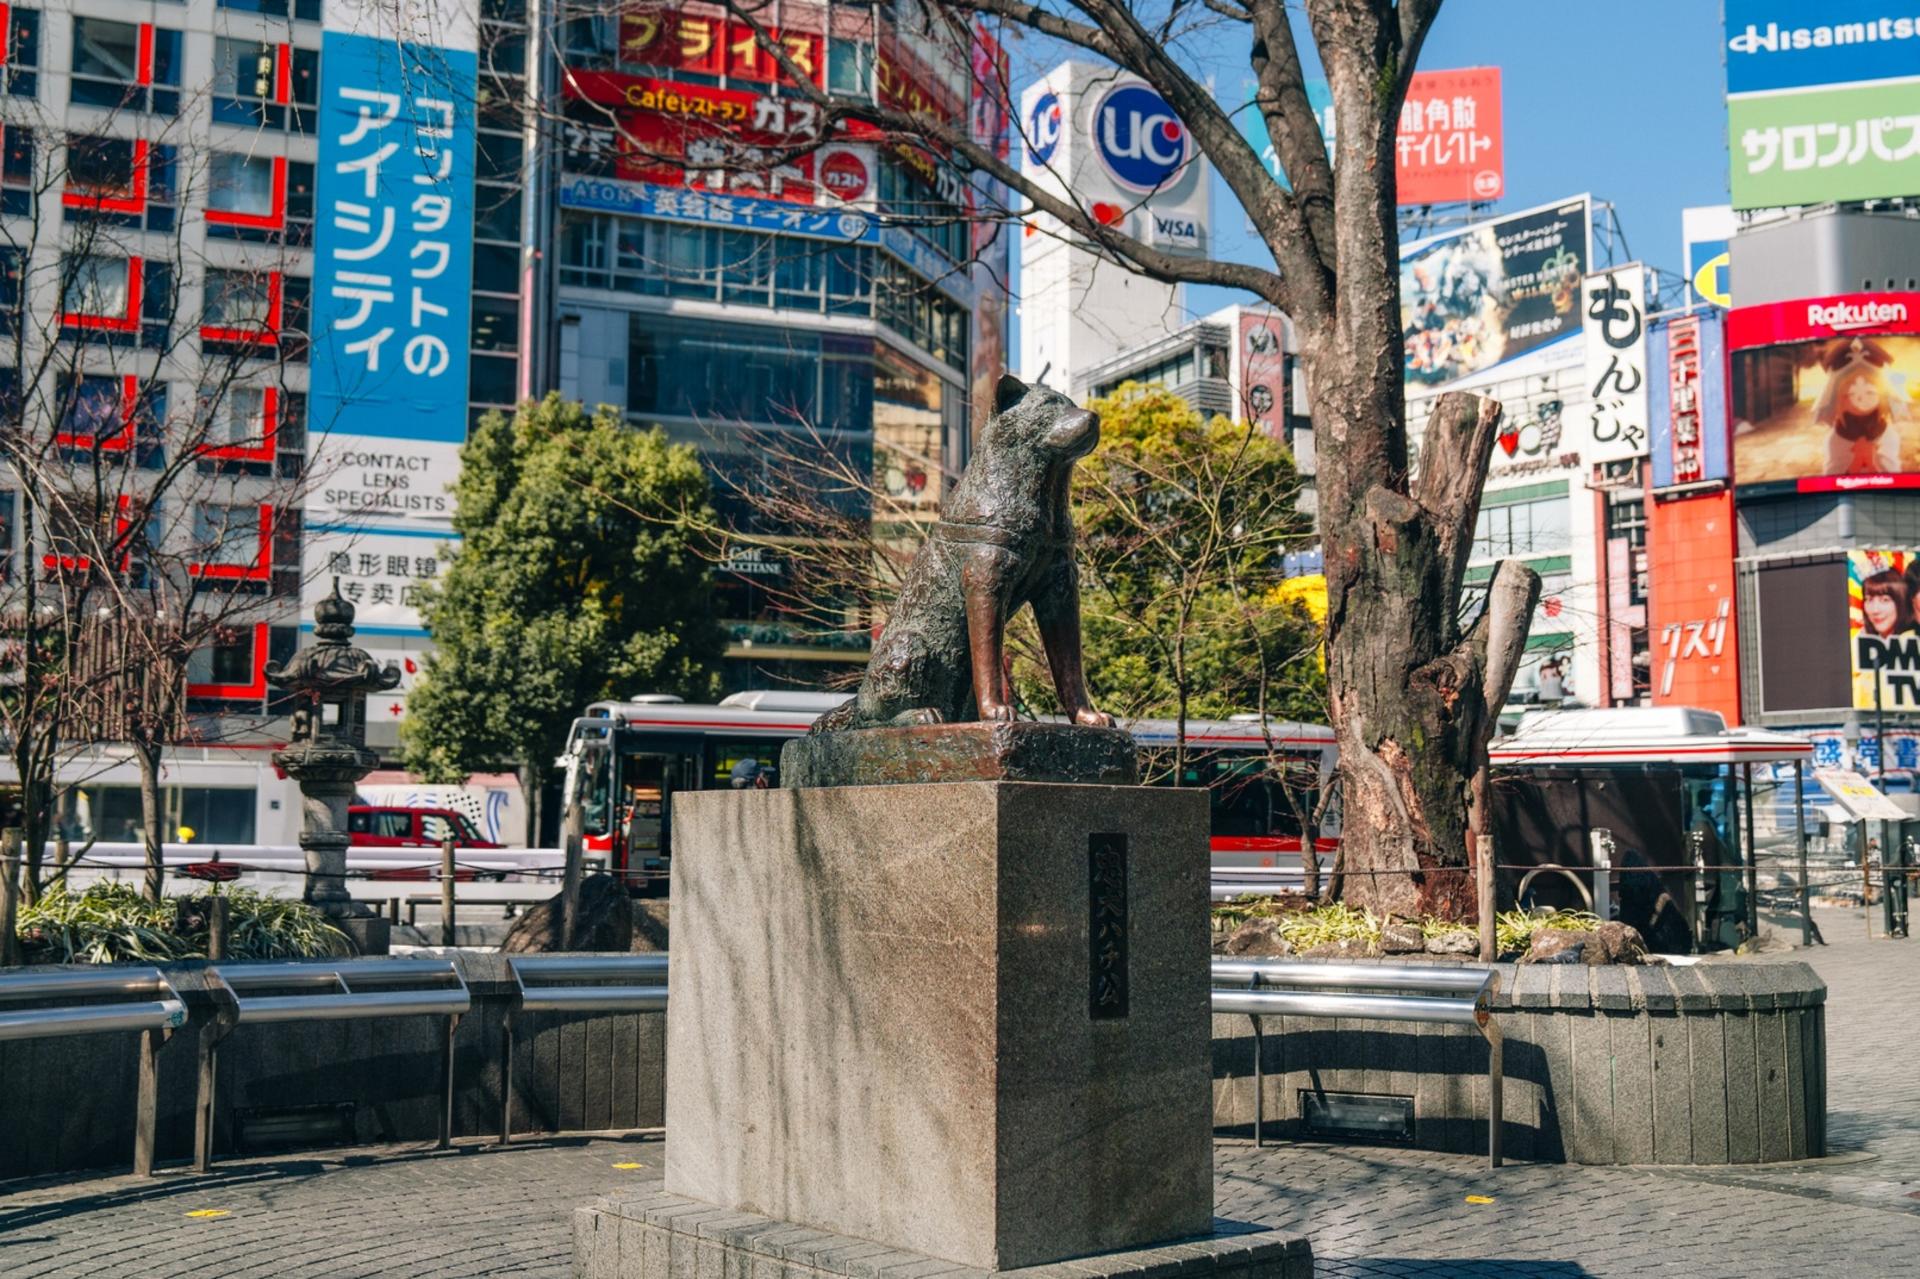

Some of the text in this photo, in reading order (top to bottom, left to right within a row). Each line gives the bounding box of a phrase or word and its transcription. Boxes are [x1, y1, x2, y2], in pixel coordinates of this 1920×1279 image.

[1103, 105, 1180, 166] UC
[1742, 115, 1920, 174] サロンパス
[827, 171, 865, 188] ガスト
[332, 87, 399, 373] アイシティ
[403, 97, 455, 377] コンタクトの
[1158, 219, 1196, 238] VISA
[1808, 301, 1907, 327] Rakuten
[1588, 273, 1645, 451] もんじゃ
[342, 451, 432, 472] CONTACT
[363, 472, 410, 490] LENS
[324, 489, 446, 512] SPECIALISTS
[329, 550, 438, 579] 隐形眼镜
[1659, 597, 1731, 697] クスリ
